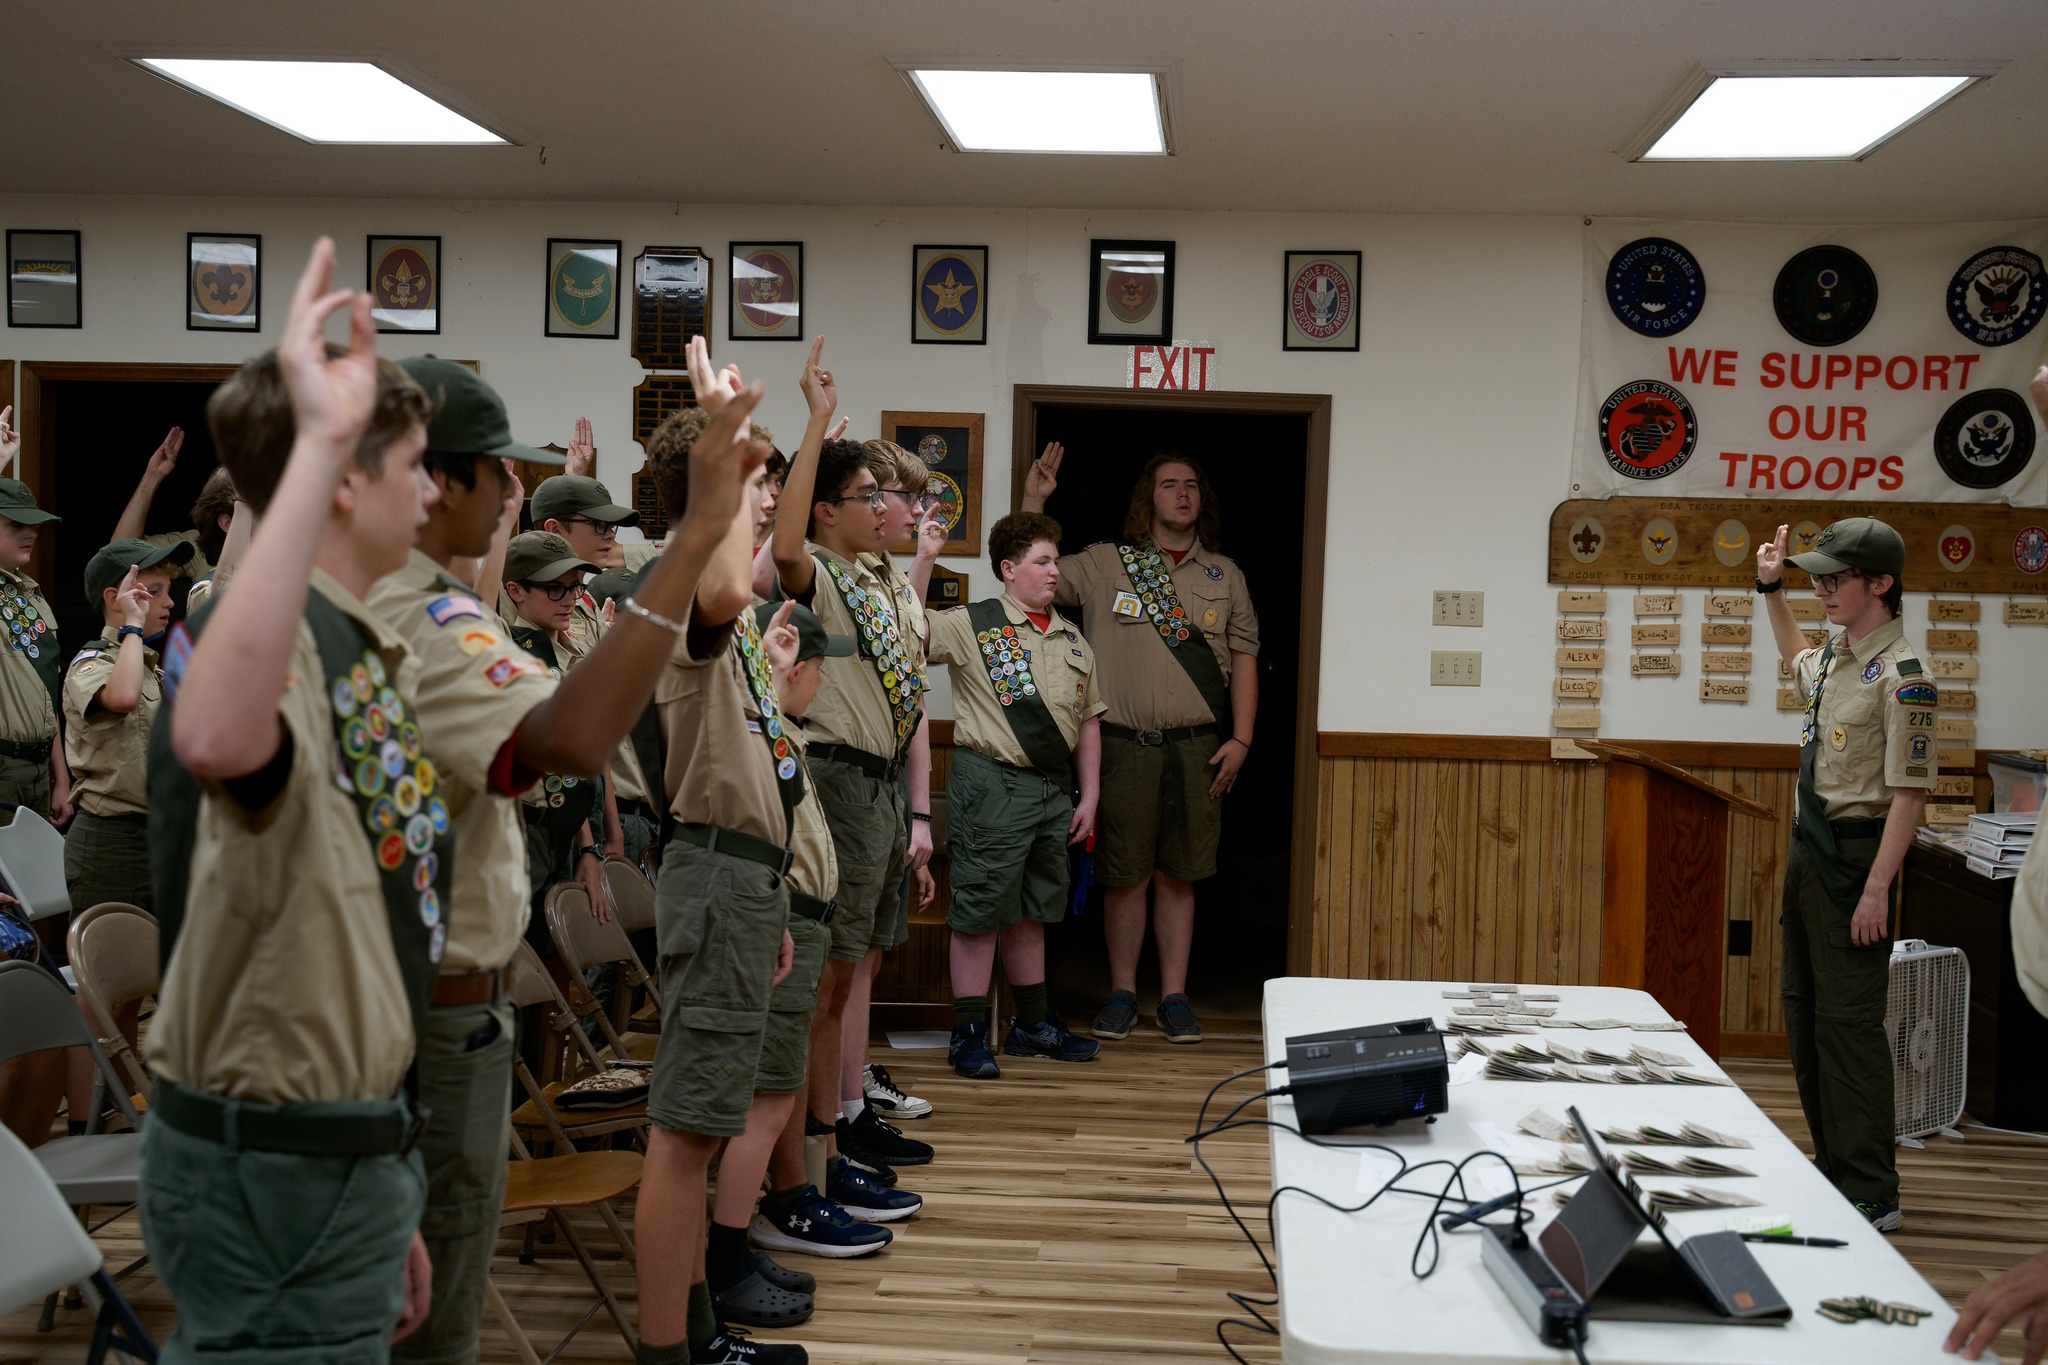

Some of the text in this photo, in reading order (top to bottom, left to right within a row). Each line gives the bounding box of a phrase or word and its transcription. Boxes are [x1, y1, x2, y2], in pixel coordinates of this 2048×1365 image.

[1618, 245, 1695, 276] UNITED STATES
[1960, 251, 2005, 281] UNITED
[1298, 265, 1345, 288] EAGLE SCOUT
[1294, 291, 1349, 336] BOY SCOUTS OF AMERICA
[1621, 304, 1688, 329] AIR FORCE
[1976, 327, 2014, 342] NAVY
[1133, 345, 1215, 392] EXIT
[1668, 346, 1980, 390] WE SUPPORT
[1607, 383, 1687, 410] UNITED STATES
[1768, 405, 1867, 441] OUR
[1607, 449, 1686, 477] MARINE CORPS
[1720, 453, 1904, 491] TROOPS
[1660, 502, 1681, 511] BSA
[1688, 503, 1721, 511] TROOP
[1731, 504, 1751, 512] 275
[1830, 505, 1880, 514] JOURNEY
[1888, 507, 1901, 515] TO
[1568, 571, 1602, 580] SCOUT
[1623, 572, 1692, 581] TENDERFOOT
[1700, 575, 1756, 583] 2nd CLAS
[1943, 581, 1969, 589] LIFE
[2013, 582, 2048, 591] EAGLE
[1566, 652, 1590, 662] ALEX
[1711, 686, 1747, 695] SPENCER
[1909, 711, 1932, 726] 275
